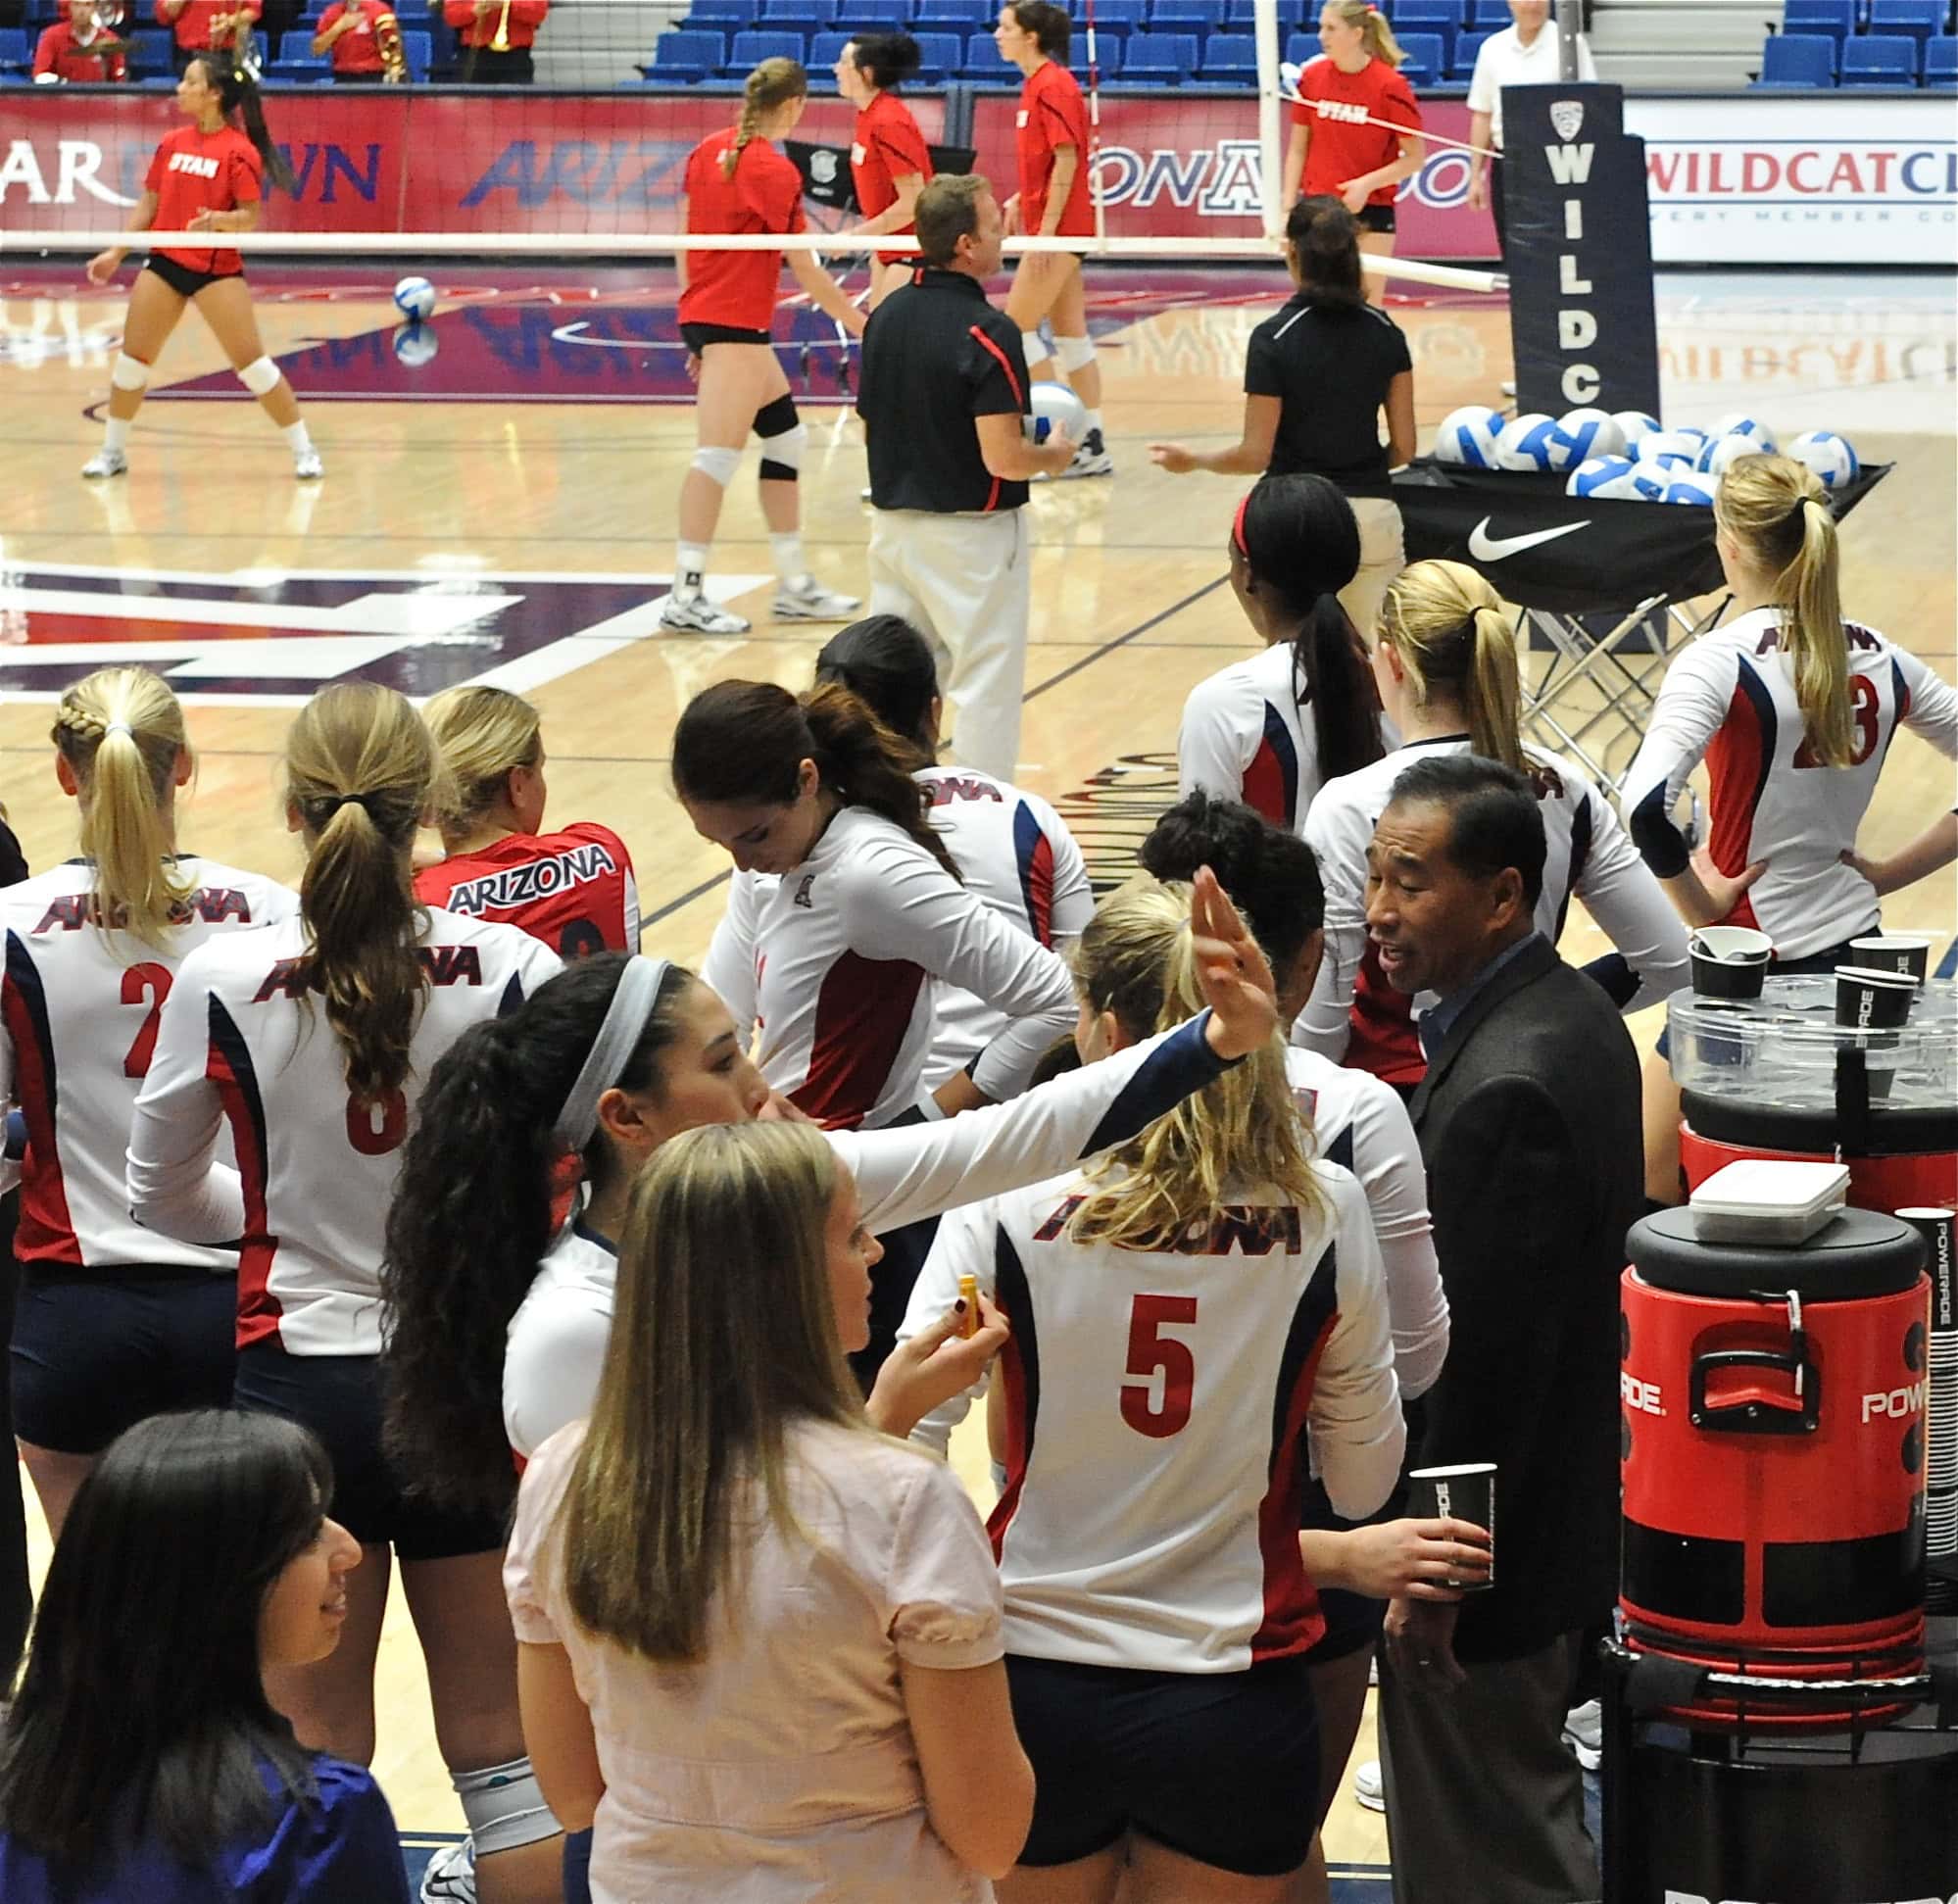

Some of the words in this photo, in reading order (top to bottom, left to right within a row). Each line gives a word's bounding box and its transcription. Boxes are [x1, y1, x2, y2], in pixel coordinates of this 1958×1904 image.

[447, 844, 615, 916] ARIZONA
[1937, 1222, 1951, 1326] POWERADE
[1120, 1294, 1198, 1440] 5
